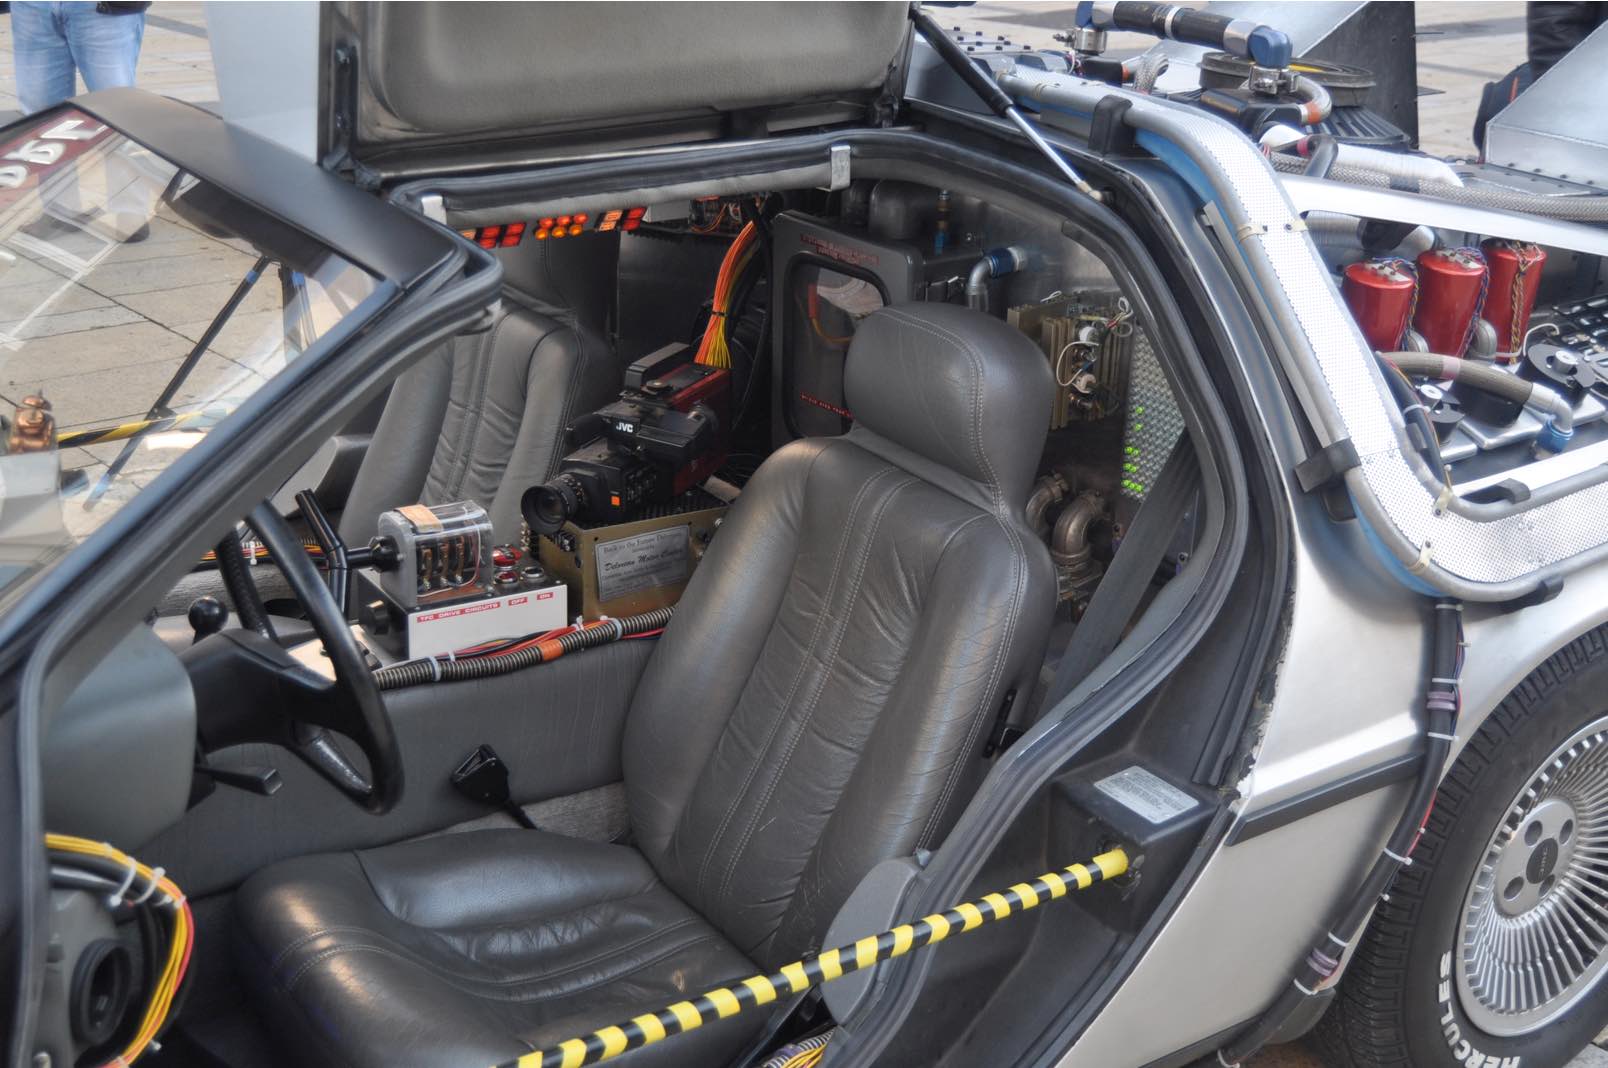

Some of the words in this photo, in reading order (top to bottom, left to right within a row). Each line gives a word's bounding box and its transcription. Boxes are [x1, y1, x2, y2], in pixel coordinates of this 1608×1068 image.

[616, 422, 634, 433] JVC
[438, 610, 461, 619] DRIVE
[464, 602, 499, 614] CIRCUITS
[1438, 950, 1520, 1068] HERCULES
